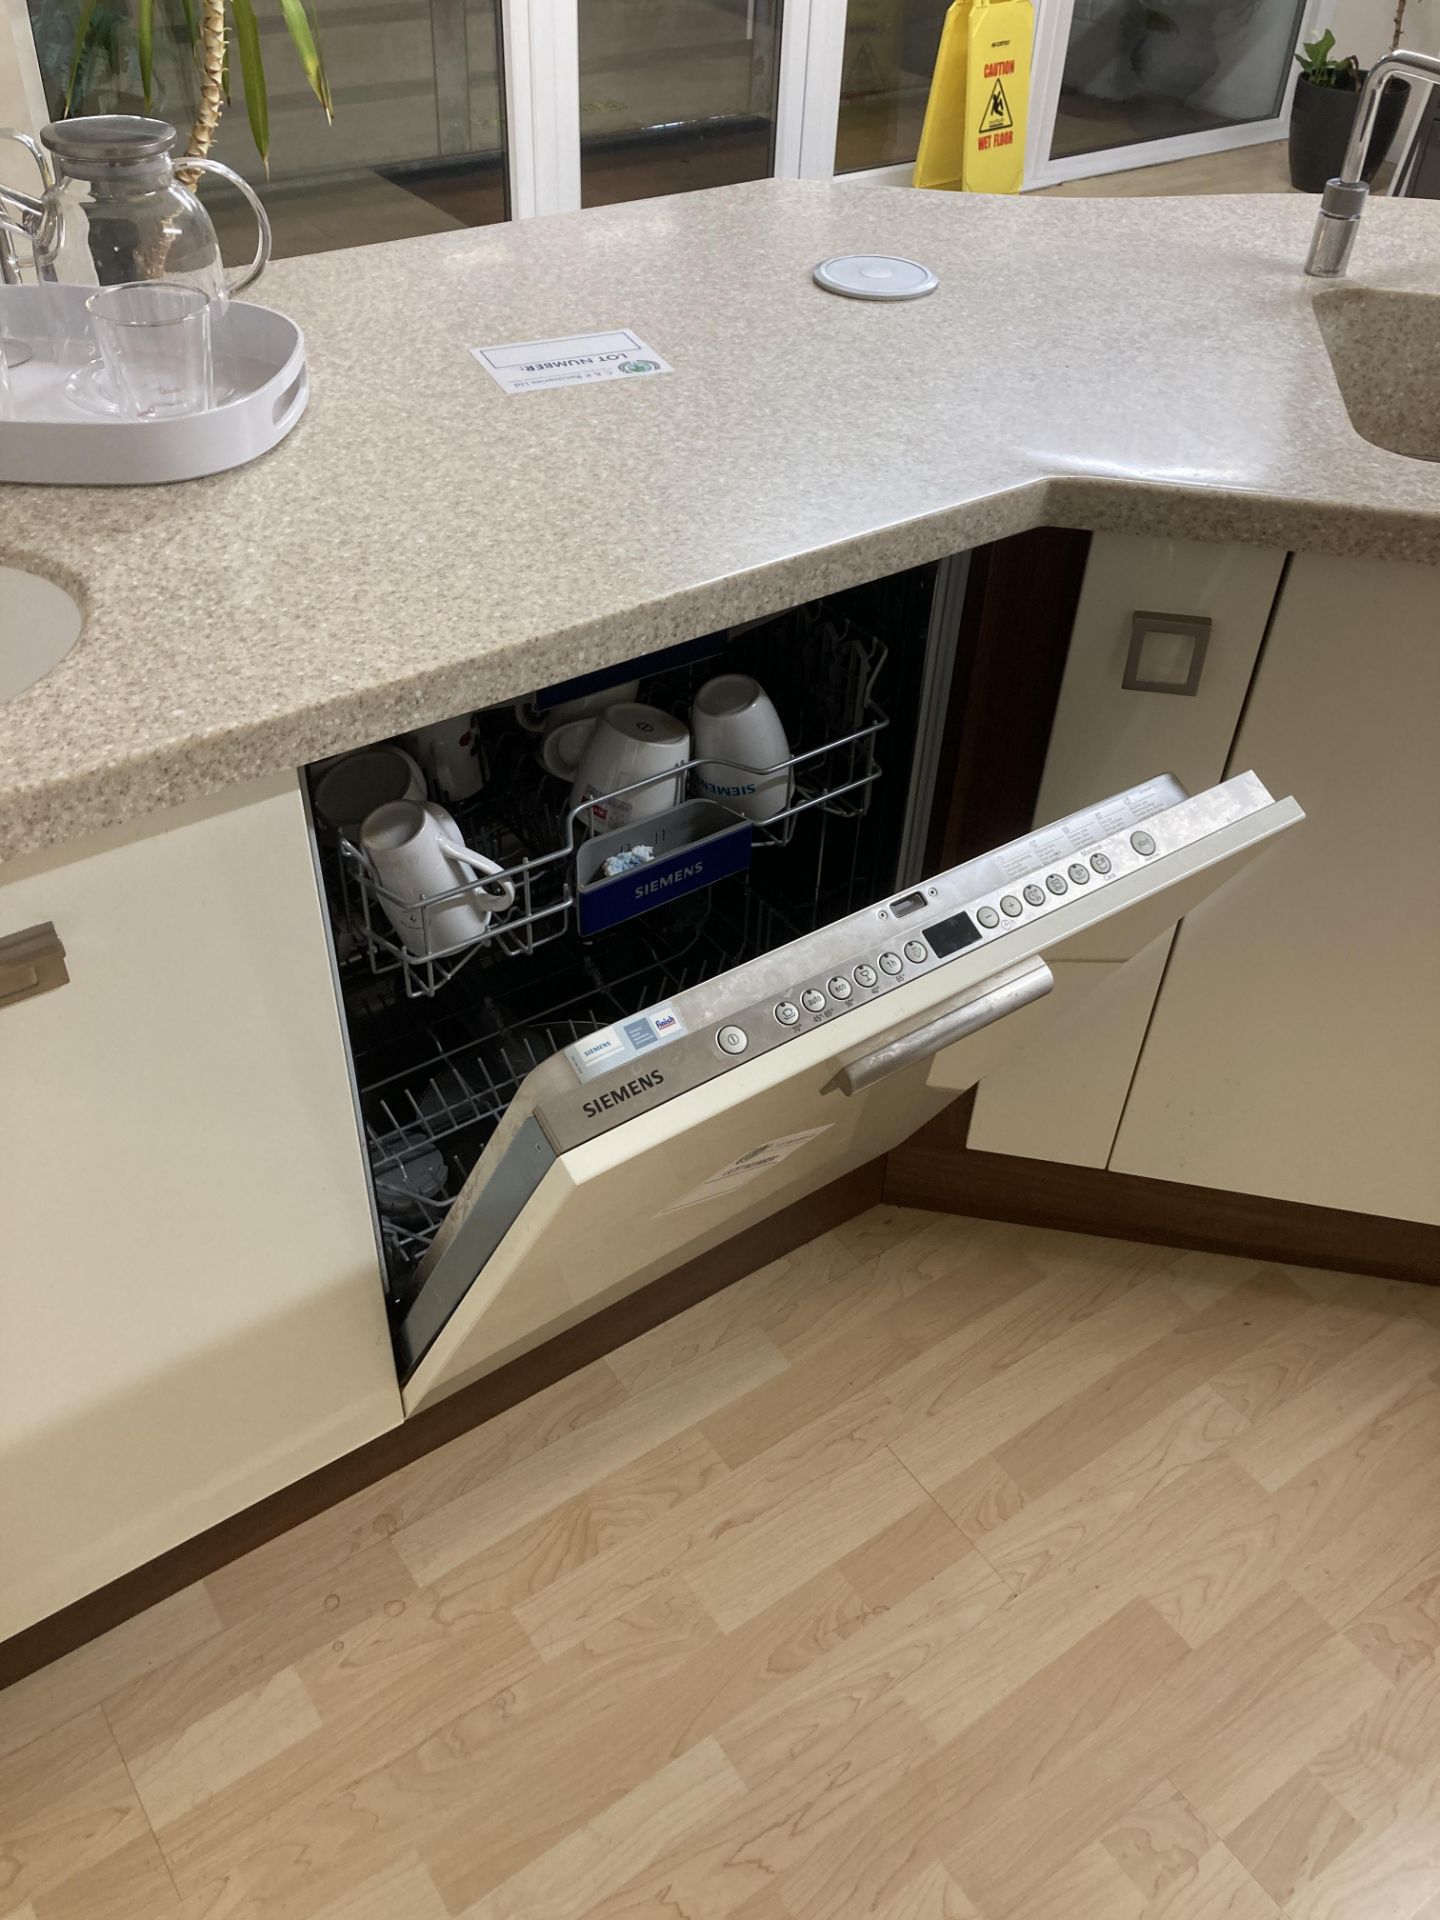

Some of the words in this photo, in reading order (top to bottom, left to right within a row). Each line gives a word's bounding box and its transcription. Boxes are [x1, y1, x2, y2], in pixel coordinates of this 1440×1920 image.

[984, 59, 1015, 78] CAUTION
[978, 135, 992, 151] WET
[993, 131, 1013, 147] FLOOR
[520, 358, 593, 372] NUMBER:
[600, 353, 628, 362] LOT
[634, 861, 704, 899] SIEMENS
[834, 983, 847, 993] eco
[807, 994, 822, 1006] auto
[655, 1015, 676, 1029] finish
[583, 1041, 612, 1057] SIEMENS
[582, 1069, 665, 1119] SIEMENS
